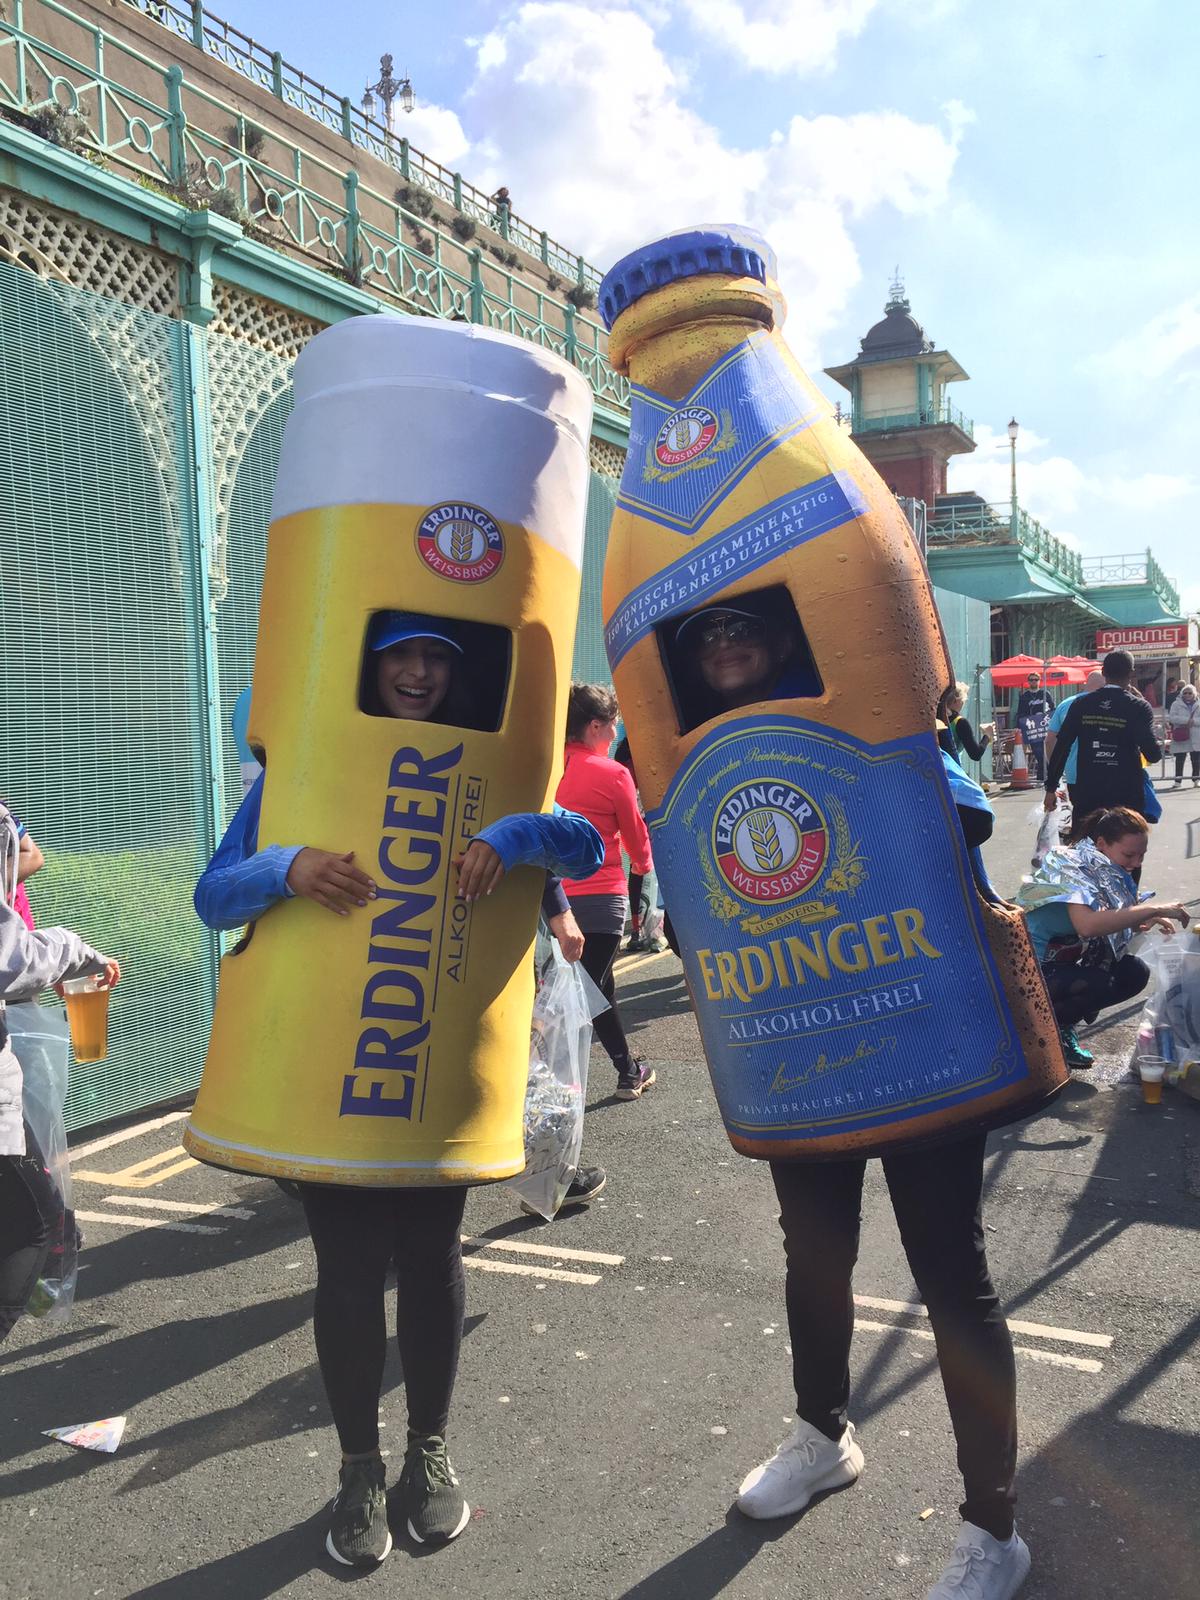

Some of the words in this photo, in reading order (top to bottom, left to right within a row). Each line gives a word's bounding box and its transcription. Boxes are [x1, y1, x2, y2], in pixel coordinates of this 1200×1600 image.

[659, 408, 712, 441] ERDINGER
[422, 506, 500, 543] ERDINGER
[608, 579, 680, 645] ISOTONISCH,
[687, 492, 835, 576] VITAMINHALTIG,
[625, 517, 806, 636] KALORIENREDUZIERT
[1102, 628, 1181, 649] GOURMET
[716, 785, 813, 844] ERDINGER
[732, 848, 820, 897] WEISSBRÄU
[339, 742, 464, 1121] ERDINGER
[754, 920, 774, 934] AUS
[775, 903, 819, 925] BAYERN
[696, 907, 943, 1003] ERDINGER
[728, 983, 924, 1040] ALKOHOLFREI
[738, 1091, 864, 1115] PRIVATBRAUEREI
[875, 1079, 915, 1097] SEIT
[924, 1065, 961, 1085] 1886
